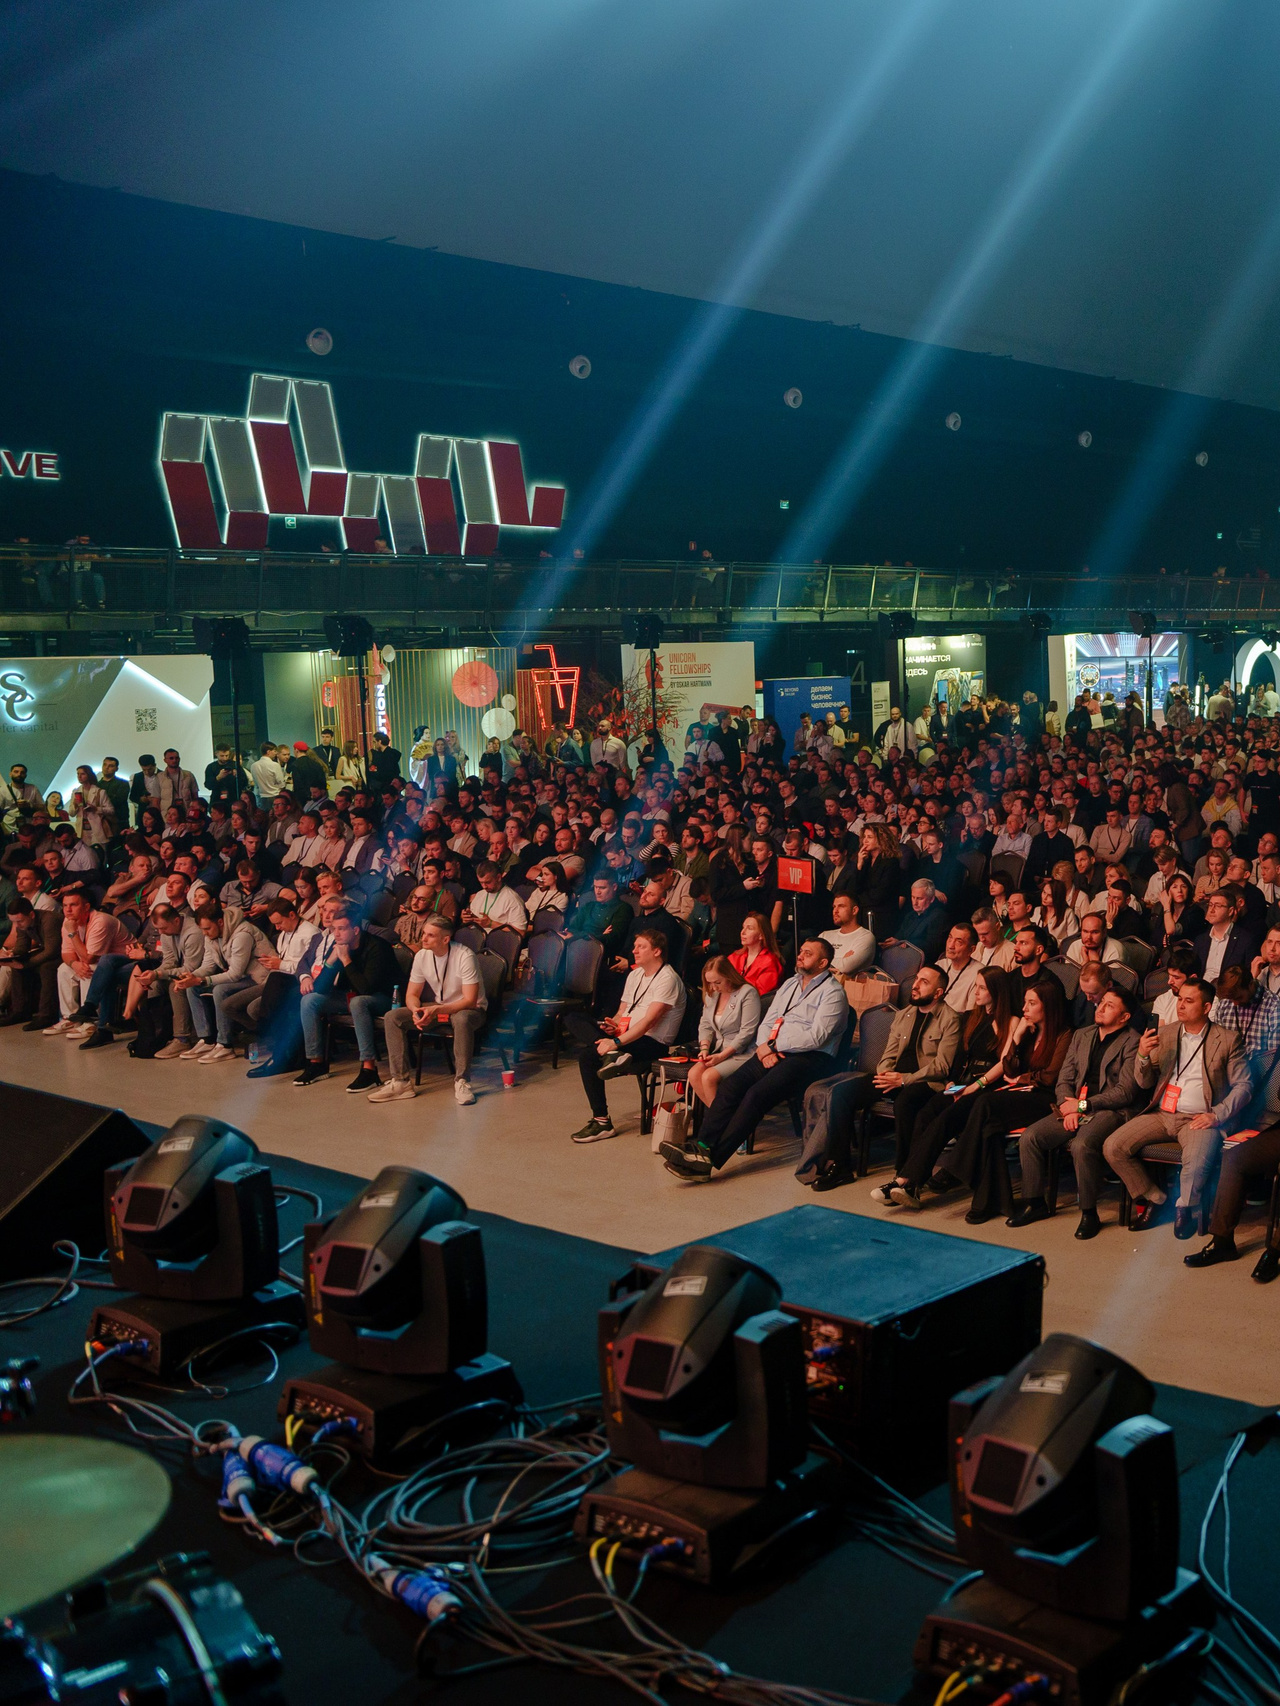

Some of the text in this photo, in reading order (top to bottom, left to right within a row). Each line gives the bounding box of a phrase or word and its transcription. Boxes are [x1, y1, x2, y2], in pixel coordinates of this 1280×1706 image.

[0, 450, 60, 480] VE
[669, 653, 696, 663] UNICORN
[670, 663, 711, 674] FELLOWSHIPS
[0, 721, 58, 733] fer capital
[789, 867, 803, 885] VIP
